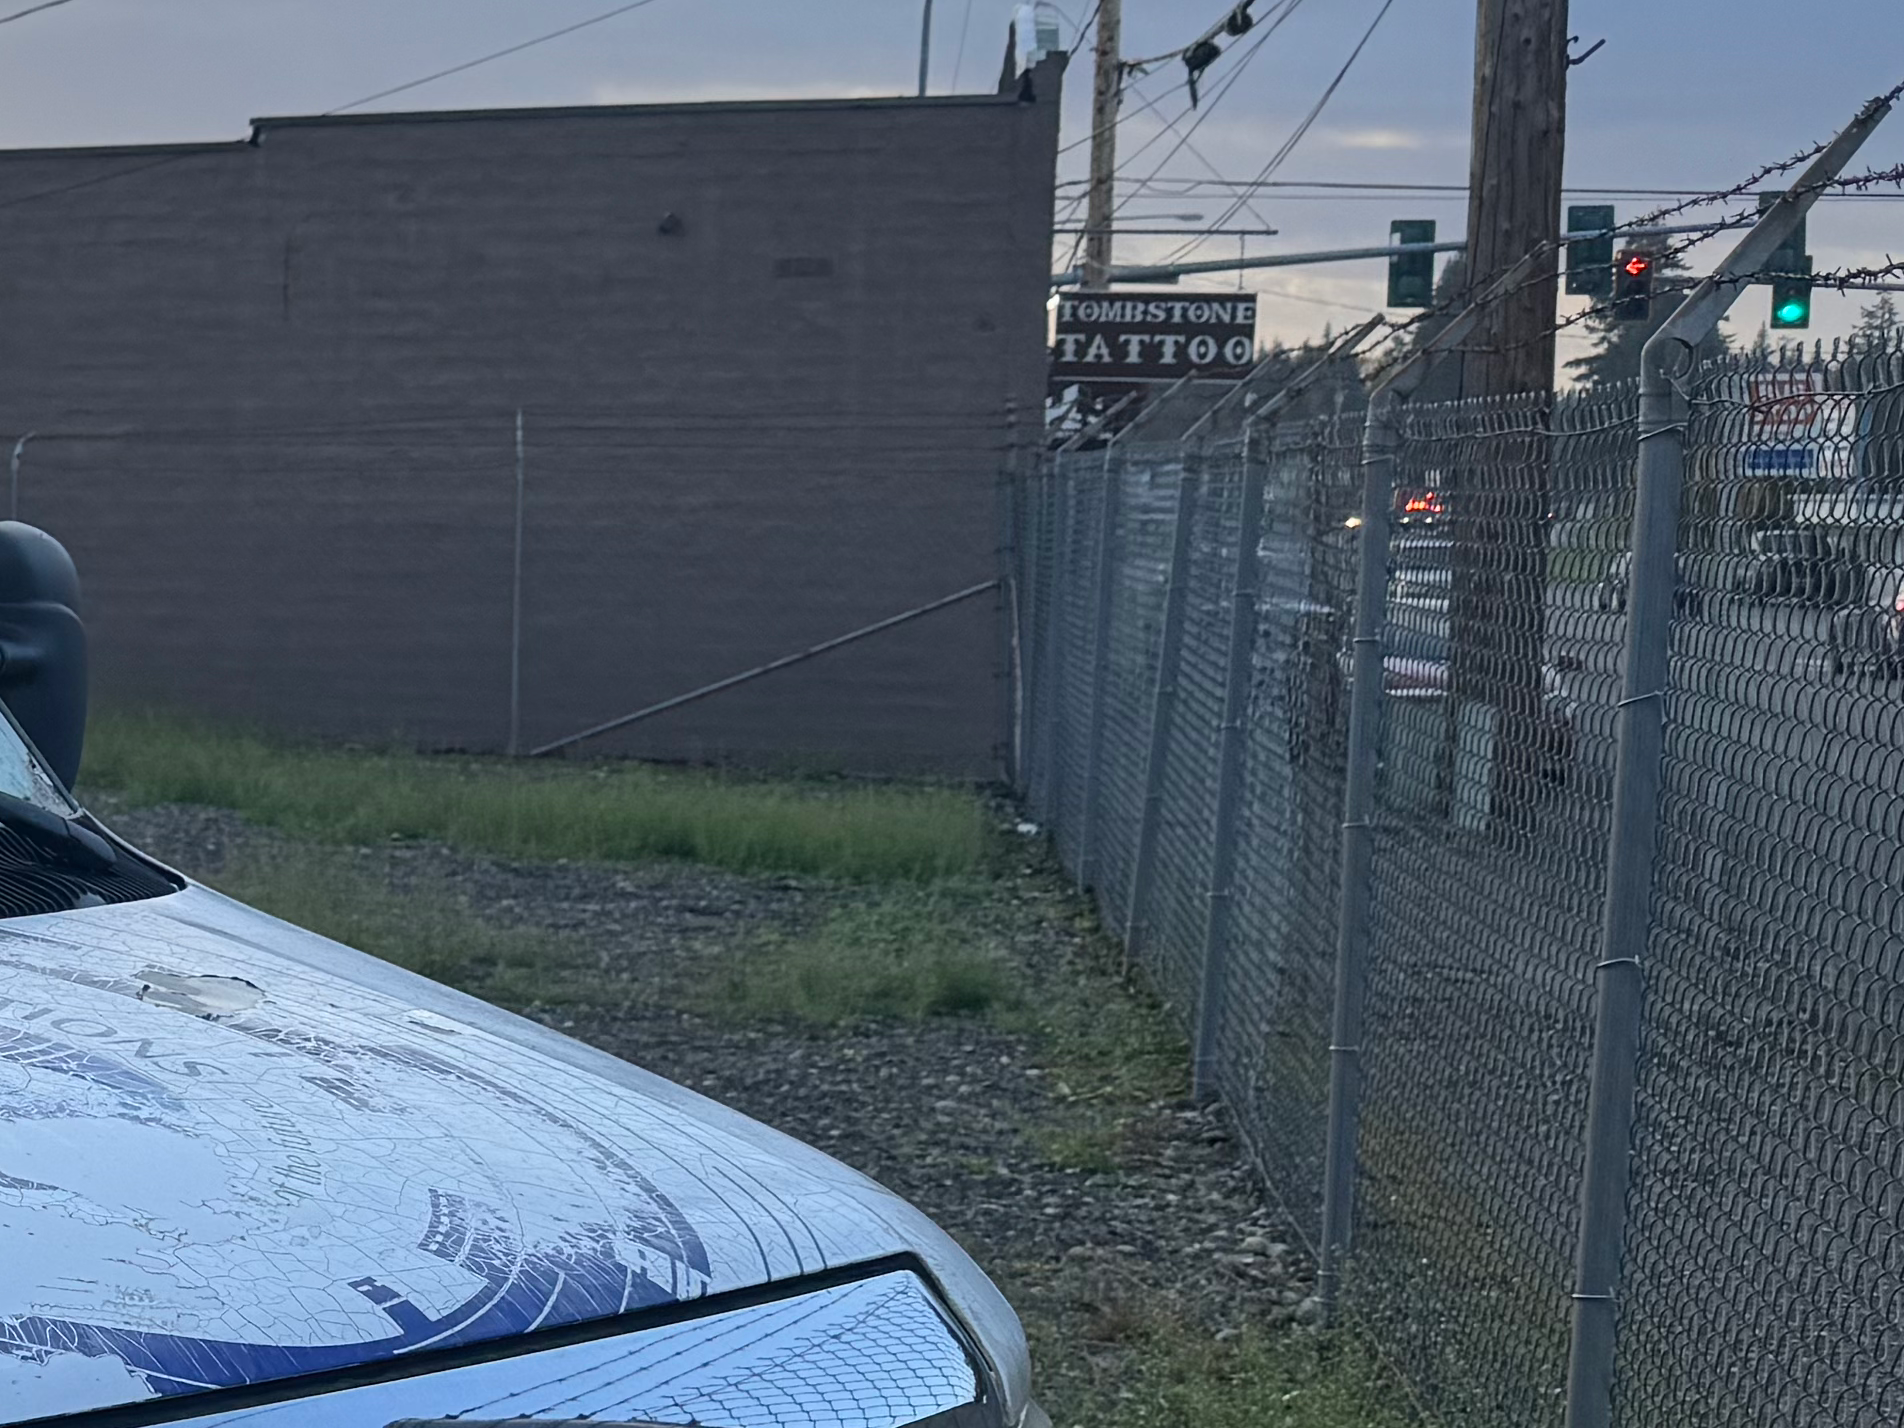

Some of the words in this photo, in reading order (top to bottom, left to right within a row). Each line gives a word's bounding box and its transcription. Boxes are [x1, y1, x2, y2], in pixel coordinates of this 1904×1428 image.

[1060, 300, 1256, 324] TOMBSTONE
[1056, 333, 1252, 365] TATTOO
[272, 1154, 322, 1186] the
